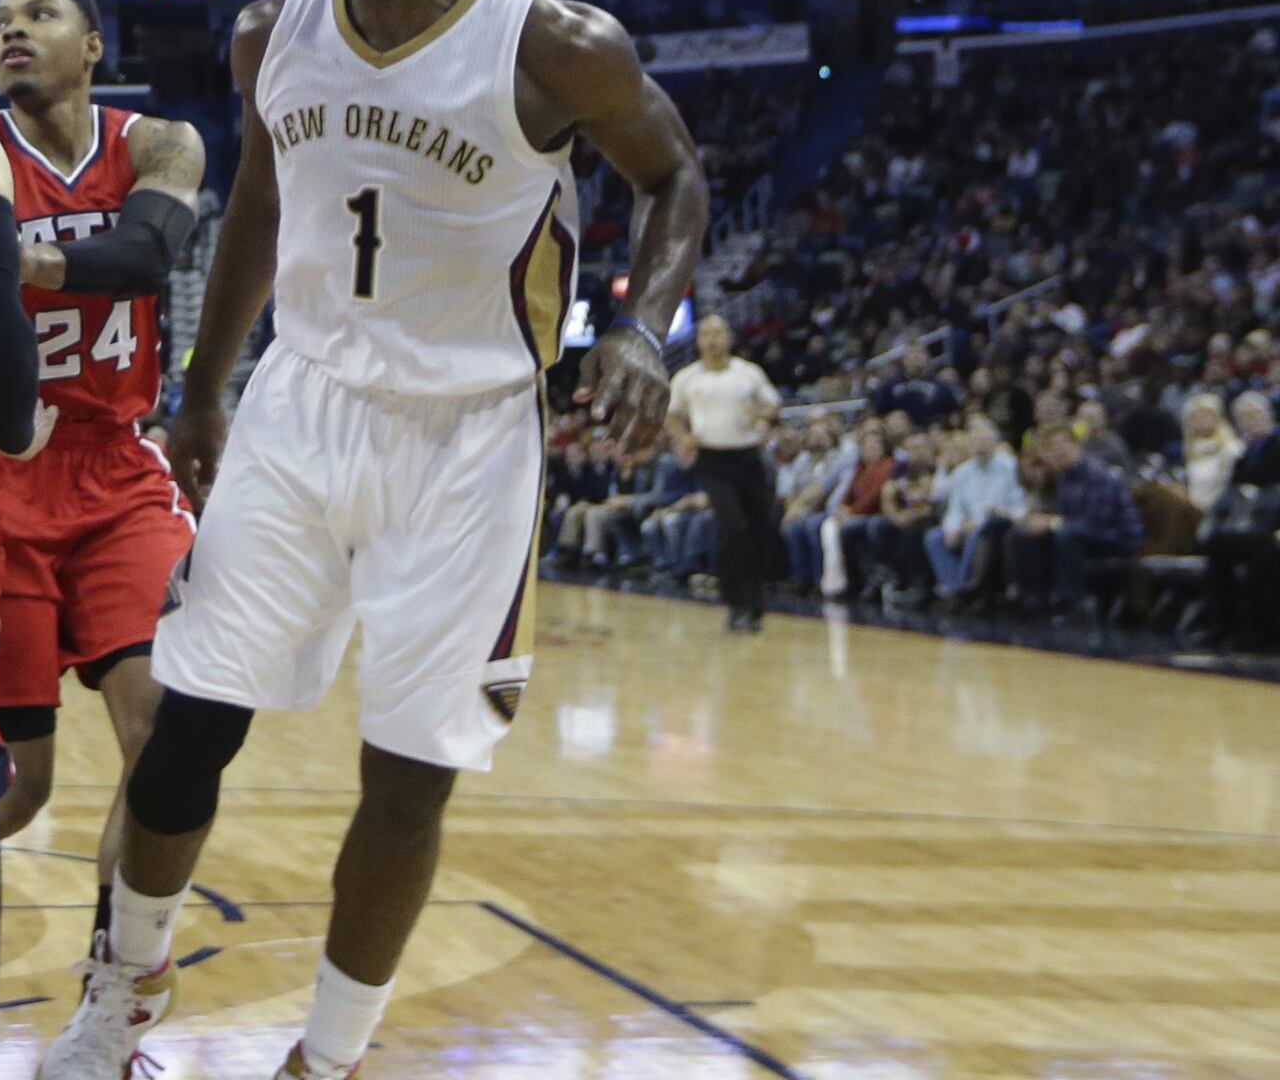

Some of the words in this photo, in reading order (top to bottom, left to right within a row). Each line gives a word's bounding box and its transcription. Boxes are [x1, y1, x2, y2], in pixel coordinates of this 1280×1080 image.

[272, 104, 326, 158] NEW
[344, 103, 494, 186] ORLEANS
[346, 186, 383, 300] 1
[35, 299, 138, 380] 24
